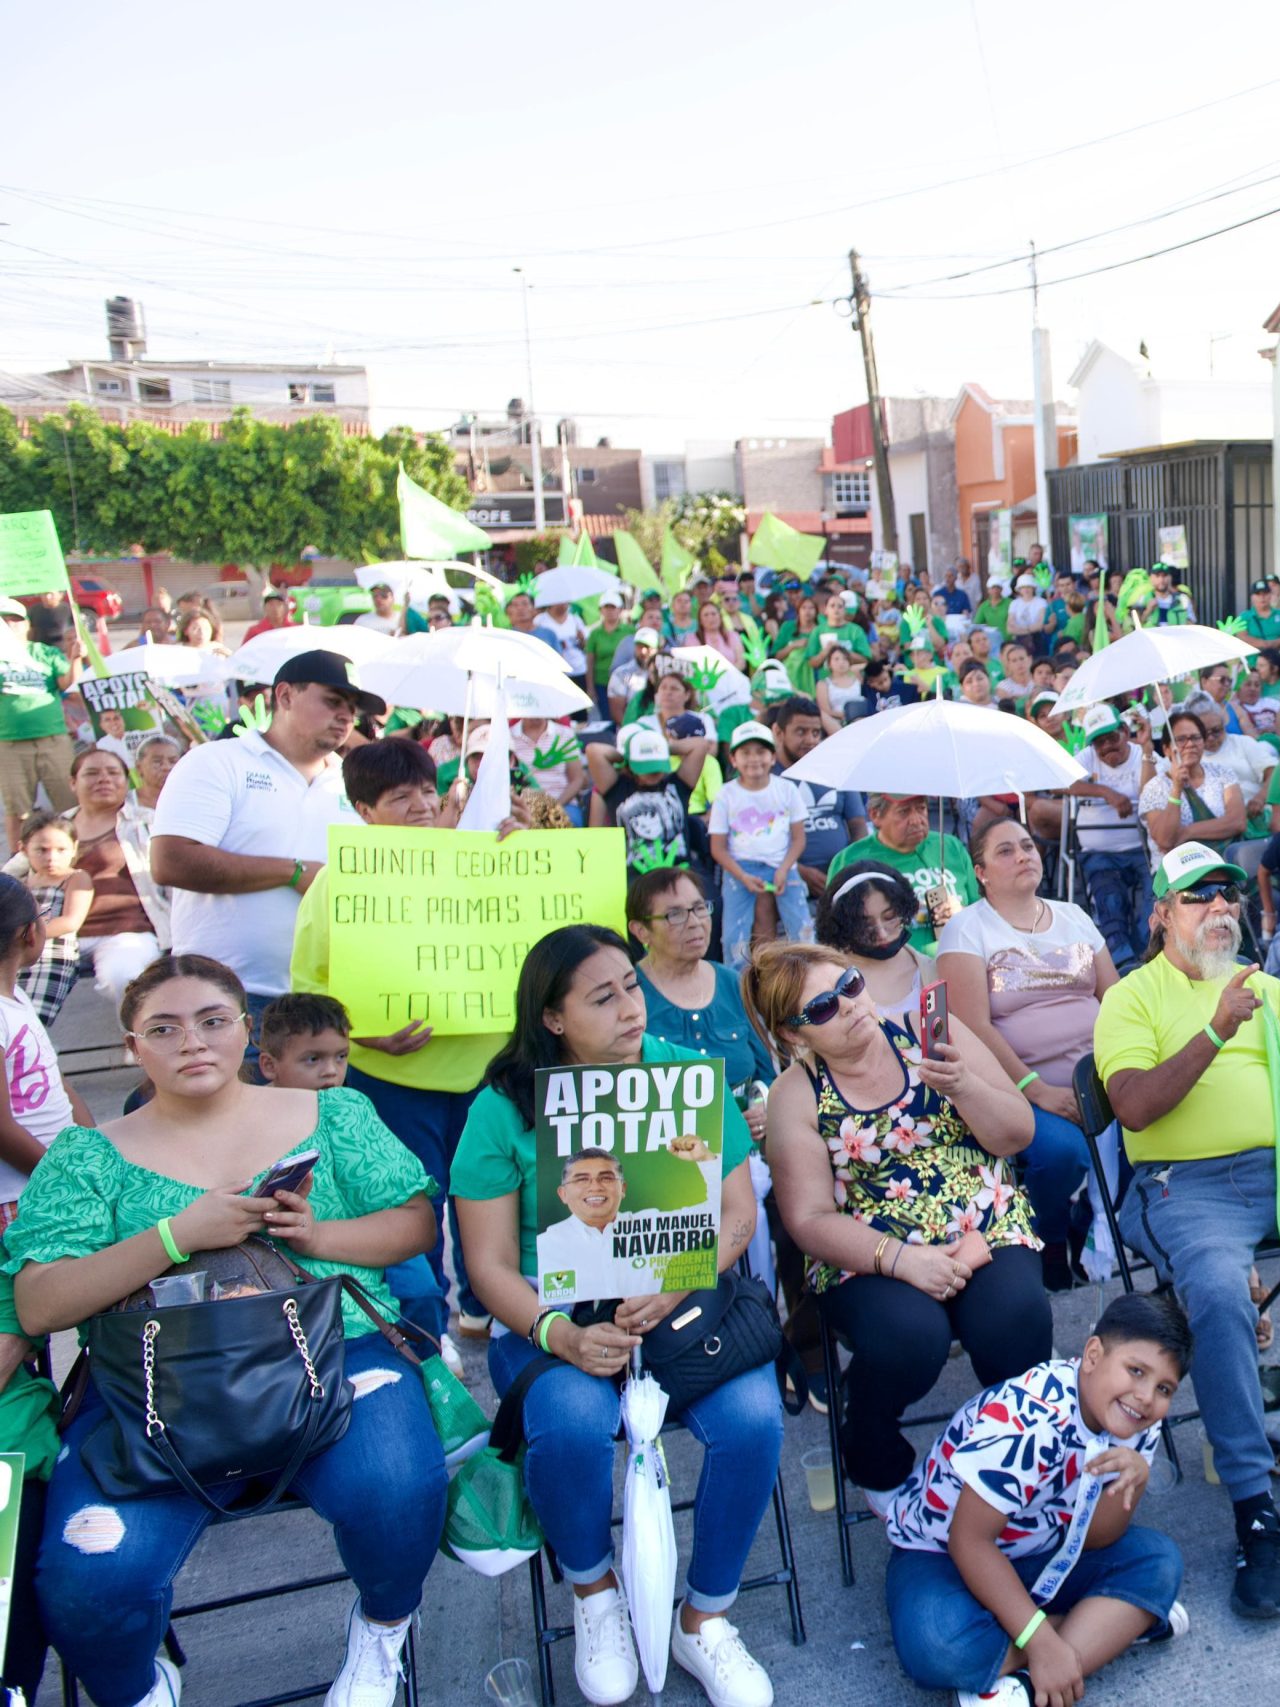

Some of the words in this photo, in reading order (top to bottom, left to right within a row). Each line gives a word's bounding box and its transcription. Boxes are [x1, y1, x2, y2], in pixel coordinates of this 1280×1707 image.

[338, 845, 435, 876] QUINTA
[455, 848, 551, 878] CEDROS
[577, 848, 591, 874] Y
[335, 893, 413, 925] CALLE
[540, 893, 584, 922] LOS
[378, 990, 518, 1022] TOTAL
[544, 1065, 715, 1116] APOYO
[549, 1109, 709, 1158] TOTAL
[613, 1216, 651, 1235] JUAN
[656, 1213, 716, 1232] MANUEL
[613, 1228, 716, 1259] NAVARRO
[649, 1250, 715, 1268] PRESIDENTE
[653, 1261, 714, 1280] MUNICIPAL
[664, 1272, 714, 1292] SOLEDAD
[545, 1286, 575, 1299] VERDE
